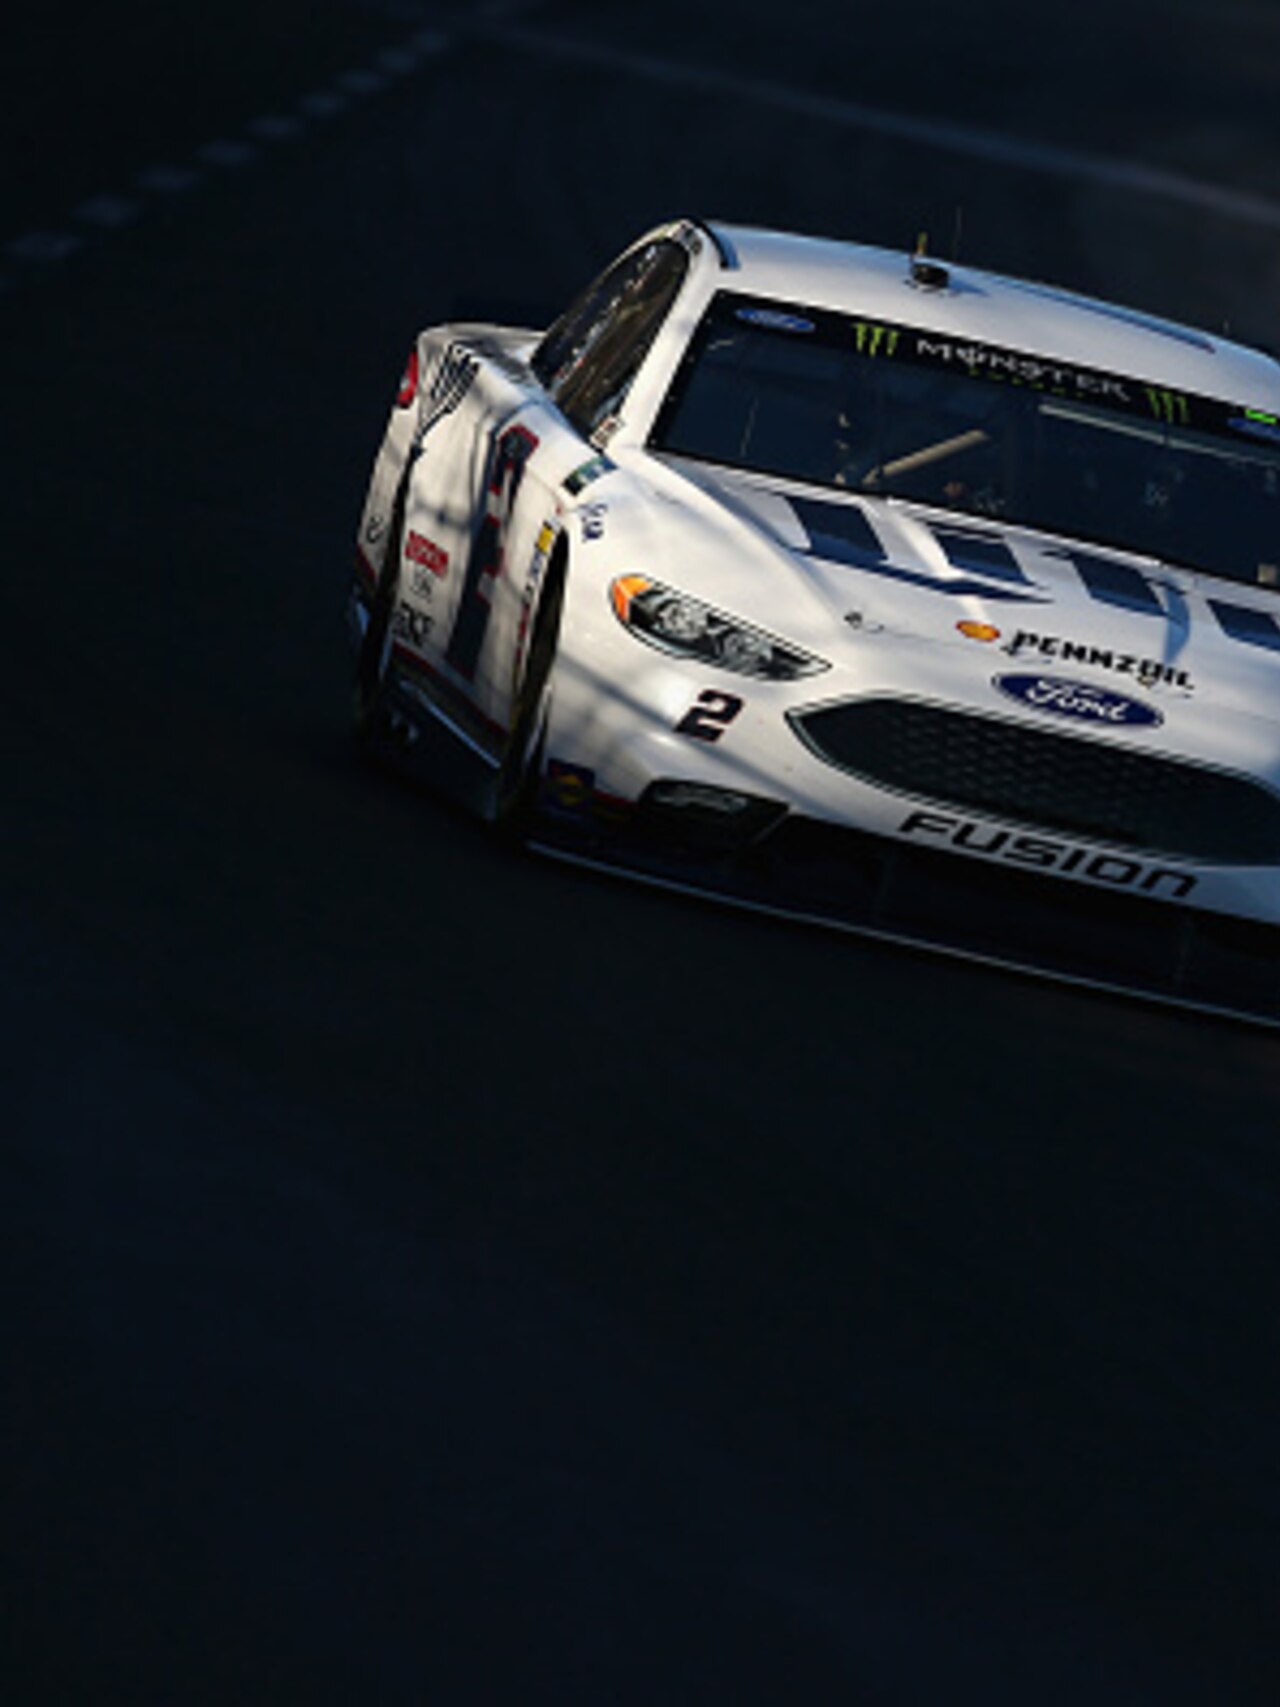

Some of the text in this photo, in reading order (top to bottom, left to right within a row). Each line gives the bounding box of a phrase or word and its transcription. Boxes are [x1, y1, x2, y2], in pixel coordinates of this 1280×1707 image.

[1002, 629, 1196, 692] PENNZOIL
[672, 689, 745, 744] 2
[1024, 679, 1131, 722] Ford
[897, 810, 1199, 899] FUSION
